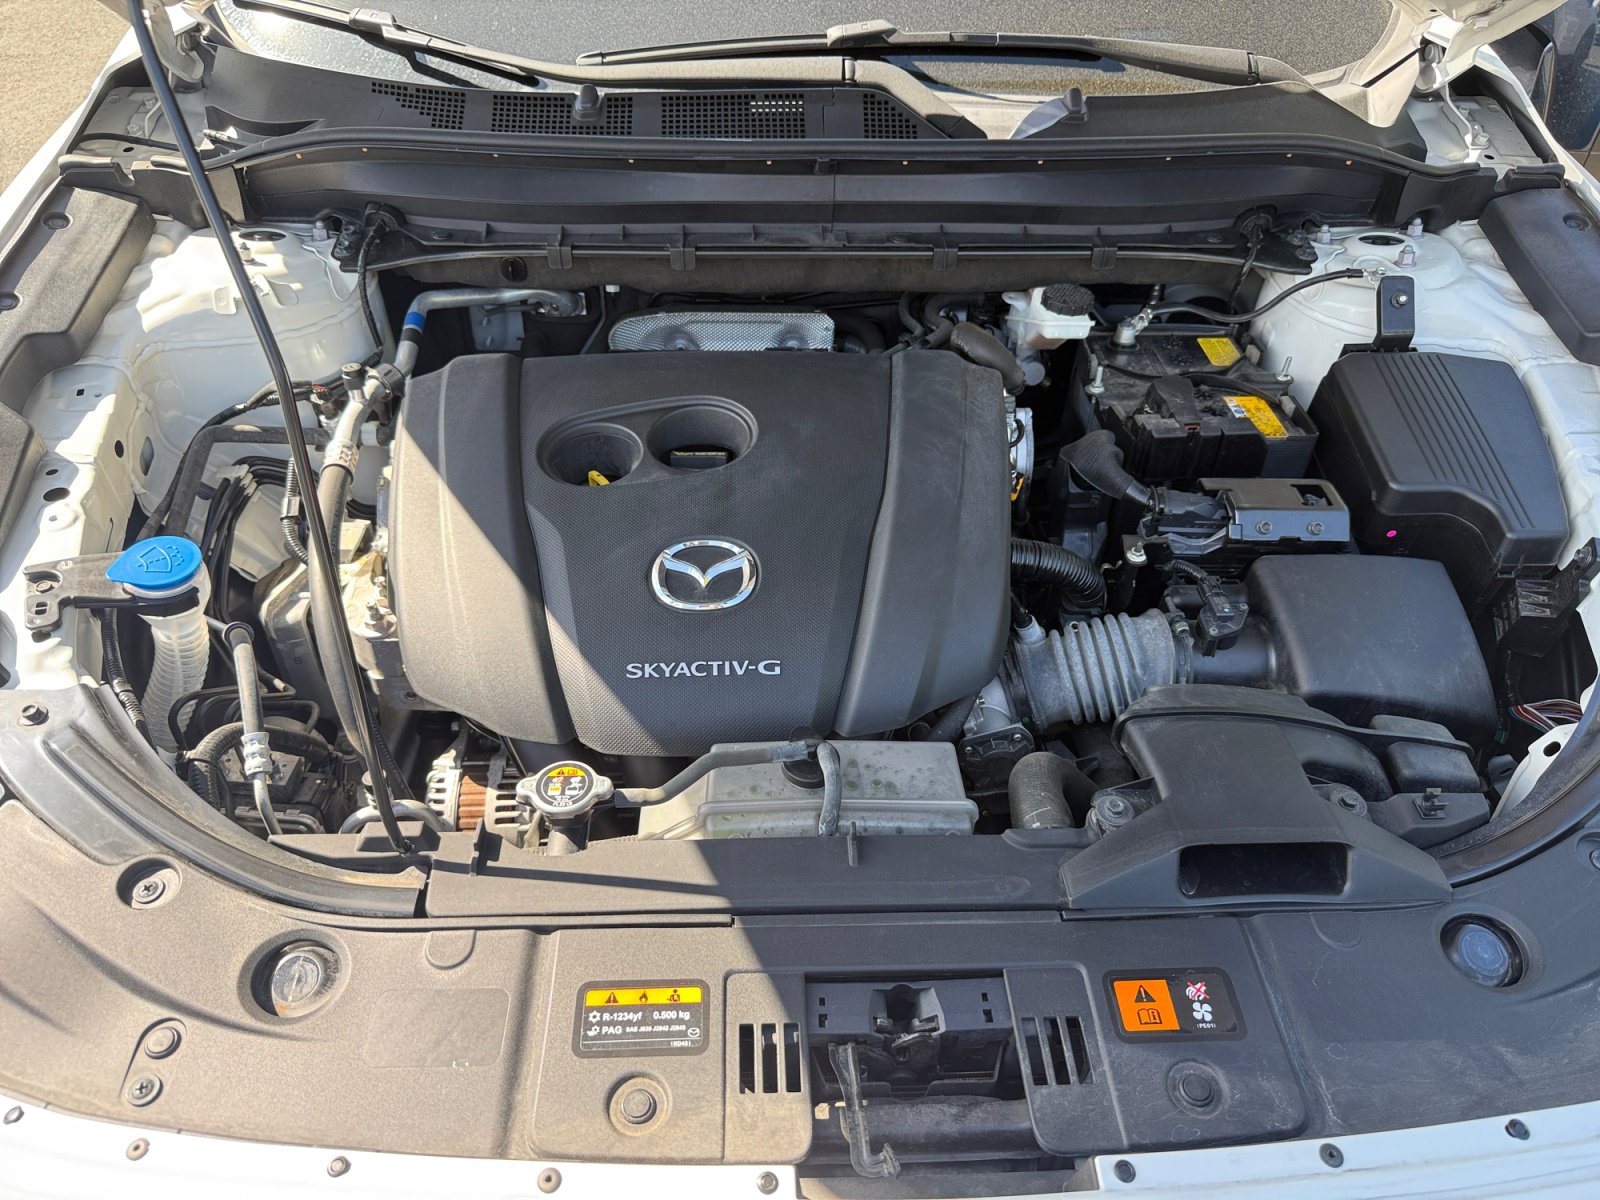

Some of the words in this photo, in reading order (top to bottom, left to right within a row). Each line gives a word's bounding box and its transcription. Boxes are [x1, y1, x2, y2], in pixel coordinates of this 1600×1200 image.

[626, 660, 781, 679] SKYACTIV-G
[602, 1011, 642, 1022] R-1234yf
[653, 1010, 677, 1020] 0.500
[679, 1010, 690, 1020] kg
[602, 1025, 622, 1034] PAG
